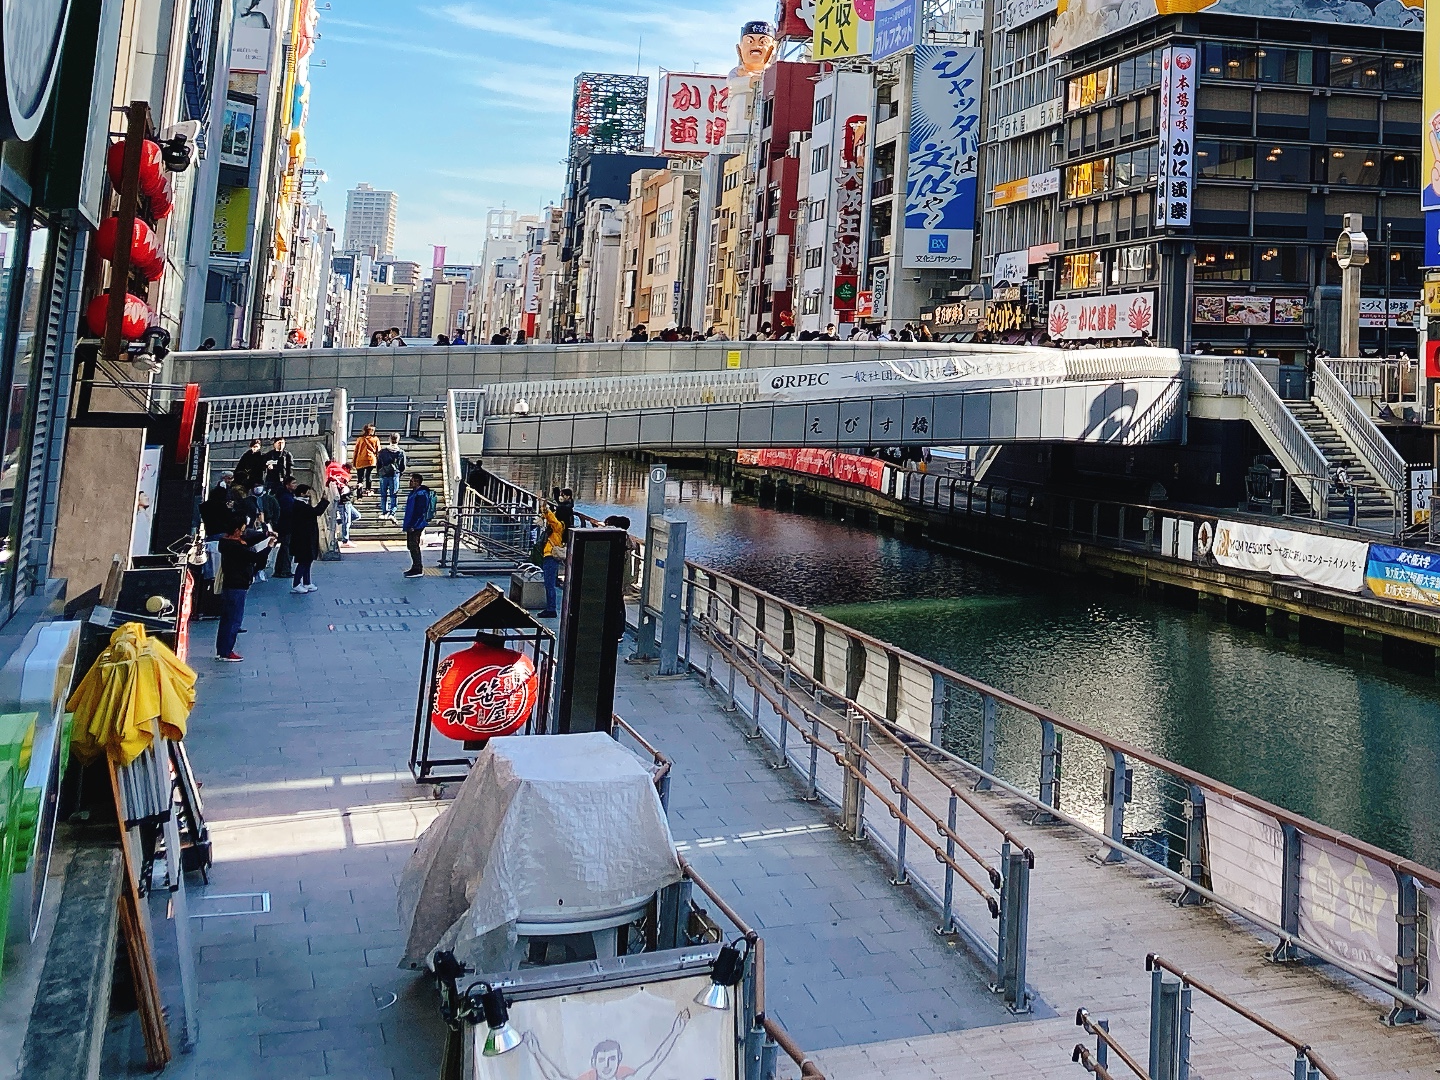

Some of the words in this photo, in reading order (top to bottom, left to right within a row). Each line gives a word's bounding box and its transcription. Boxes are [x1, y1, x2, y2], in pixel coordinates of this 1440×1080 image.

[671, 83, 729, 113] かに
[1175, 74, 1191, 133] 本場の味
[1170, 137, 1190, 221] かに道楽
[833, 161, 865, 268] 大阪王将
[931, 238, 947, 250] BX
[809, 416, 929, 434] えびす橋
